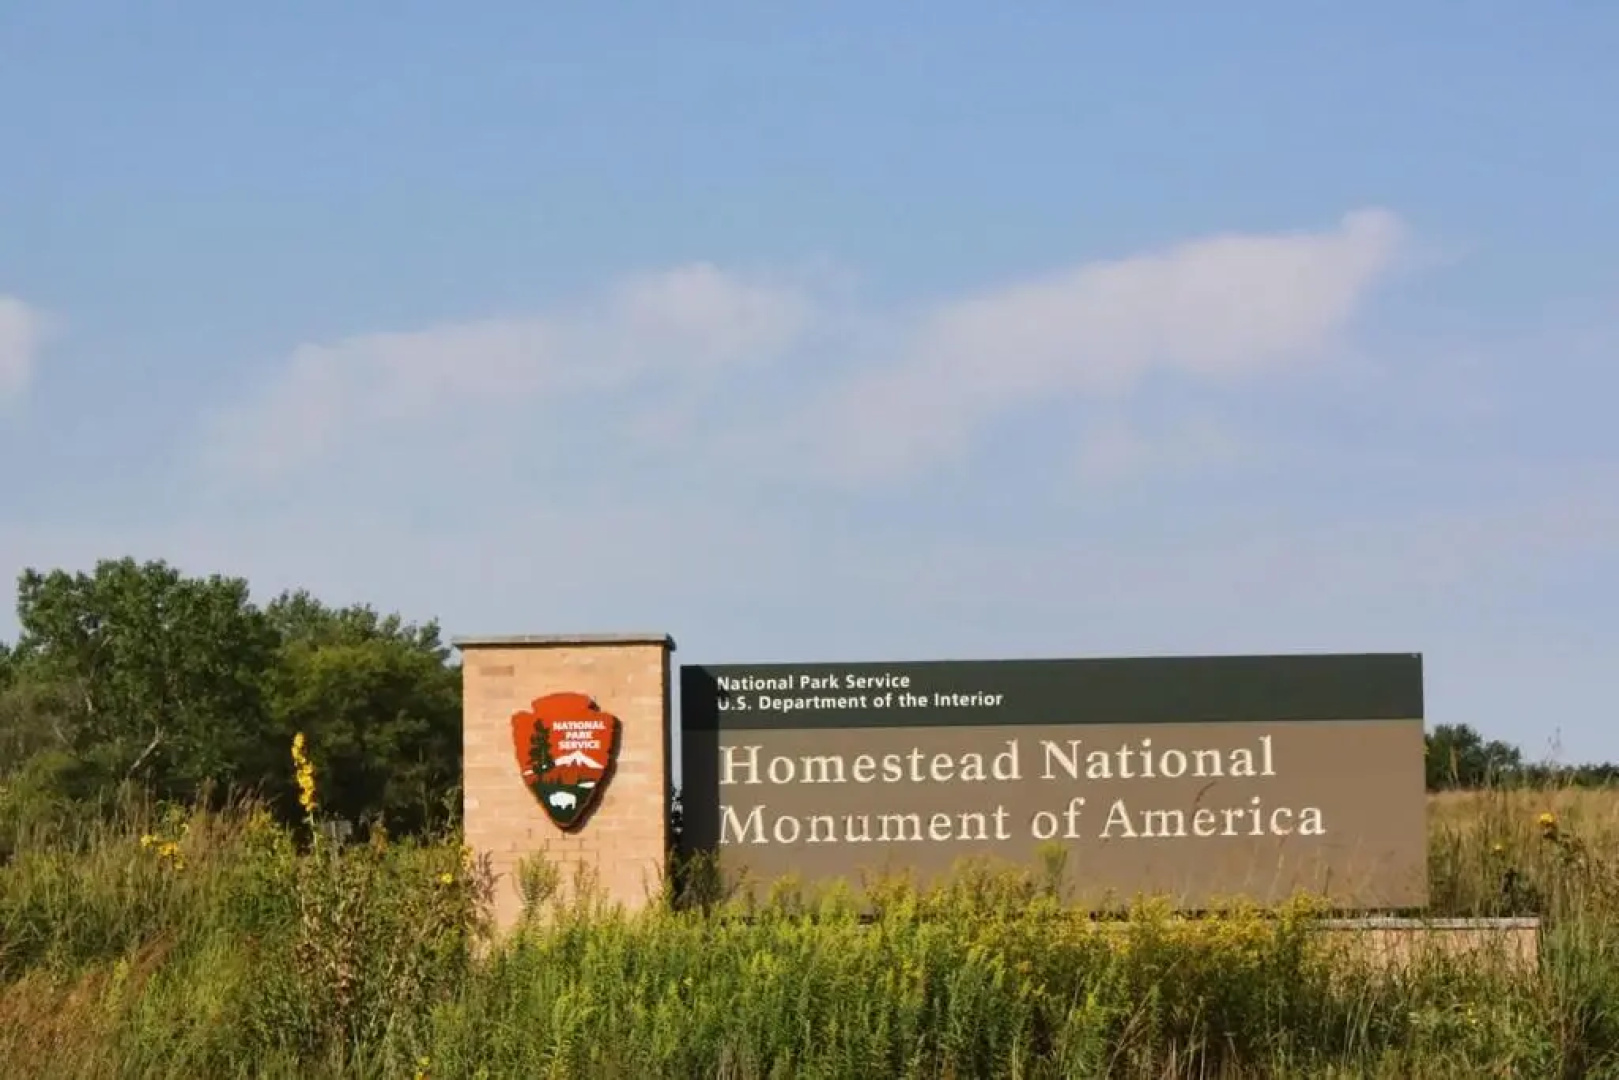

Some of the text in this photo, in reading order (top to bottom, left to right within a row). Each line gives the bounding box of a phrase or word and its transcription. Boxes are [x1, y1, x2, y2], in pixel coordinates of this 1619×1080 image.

[717, 674, 910, 691] National Park Service
[717, 691, 1004, 713] U.S. Department of the Interior
[552, 721, 606, 730] NATIONAL
[565, 731, 593, 740] PARK
[558, 740, 602, 750] SERVICE
[718, 734, 1276, 785] Homestead National
[718, 795, 1326, 844] Monument of America
